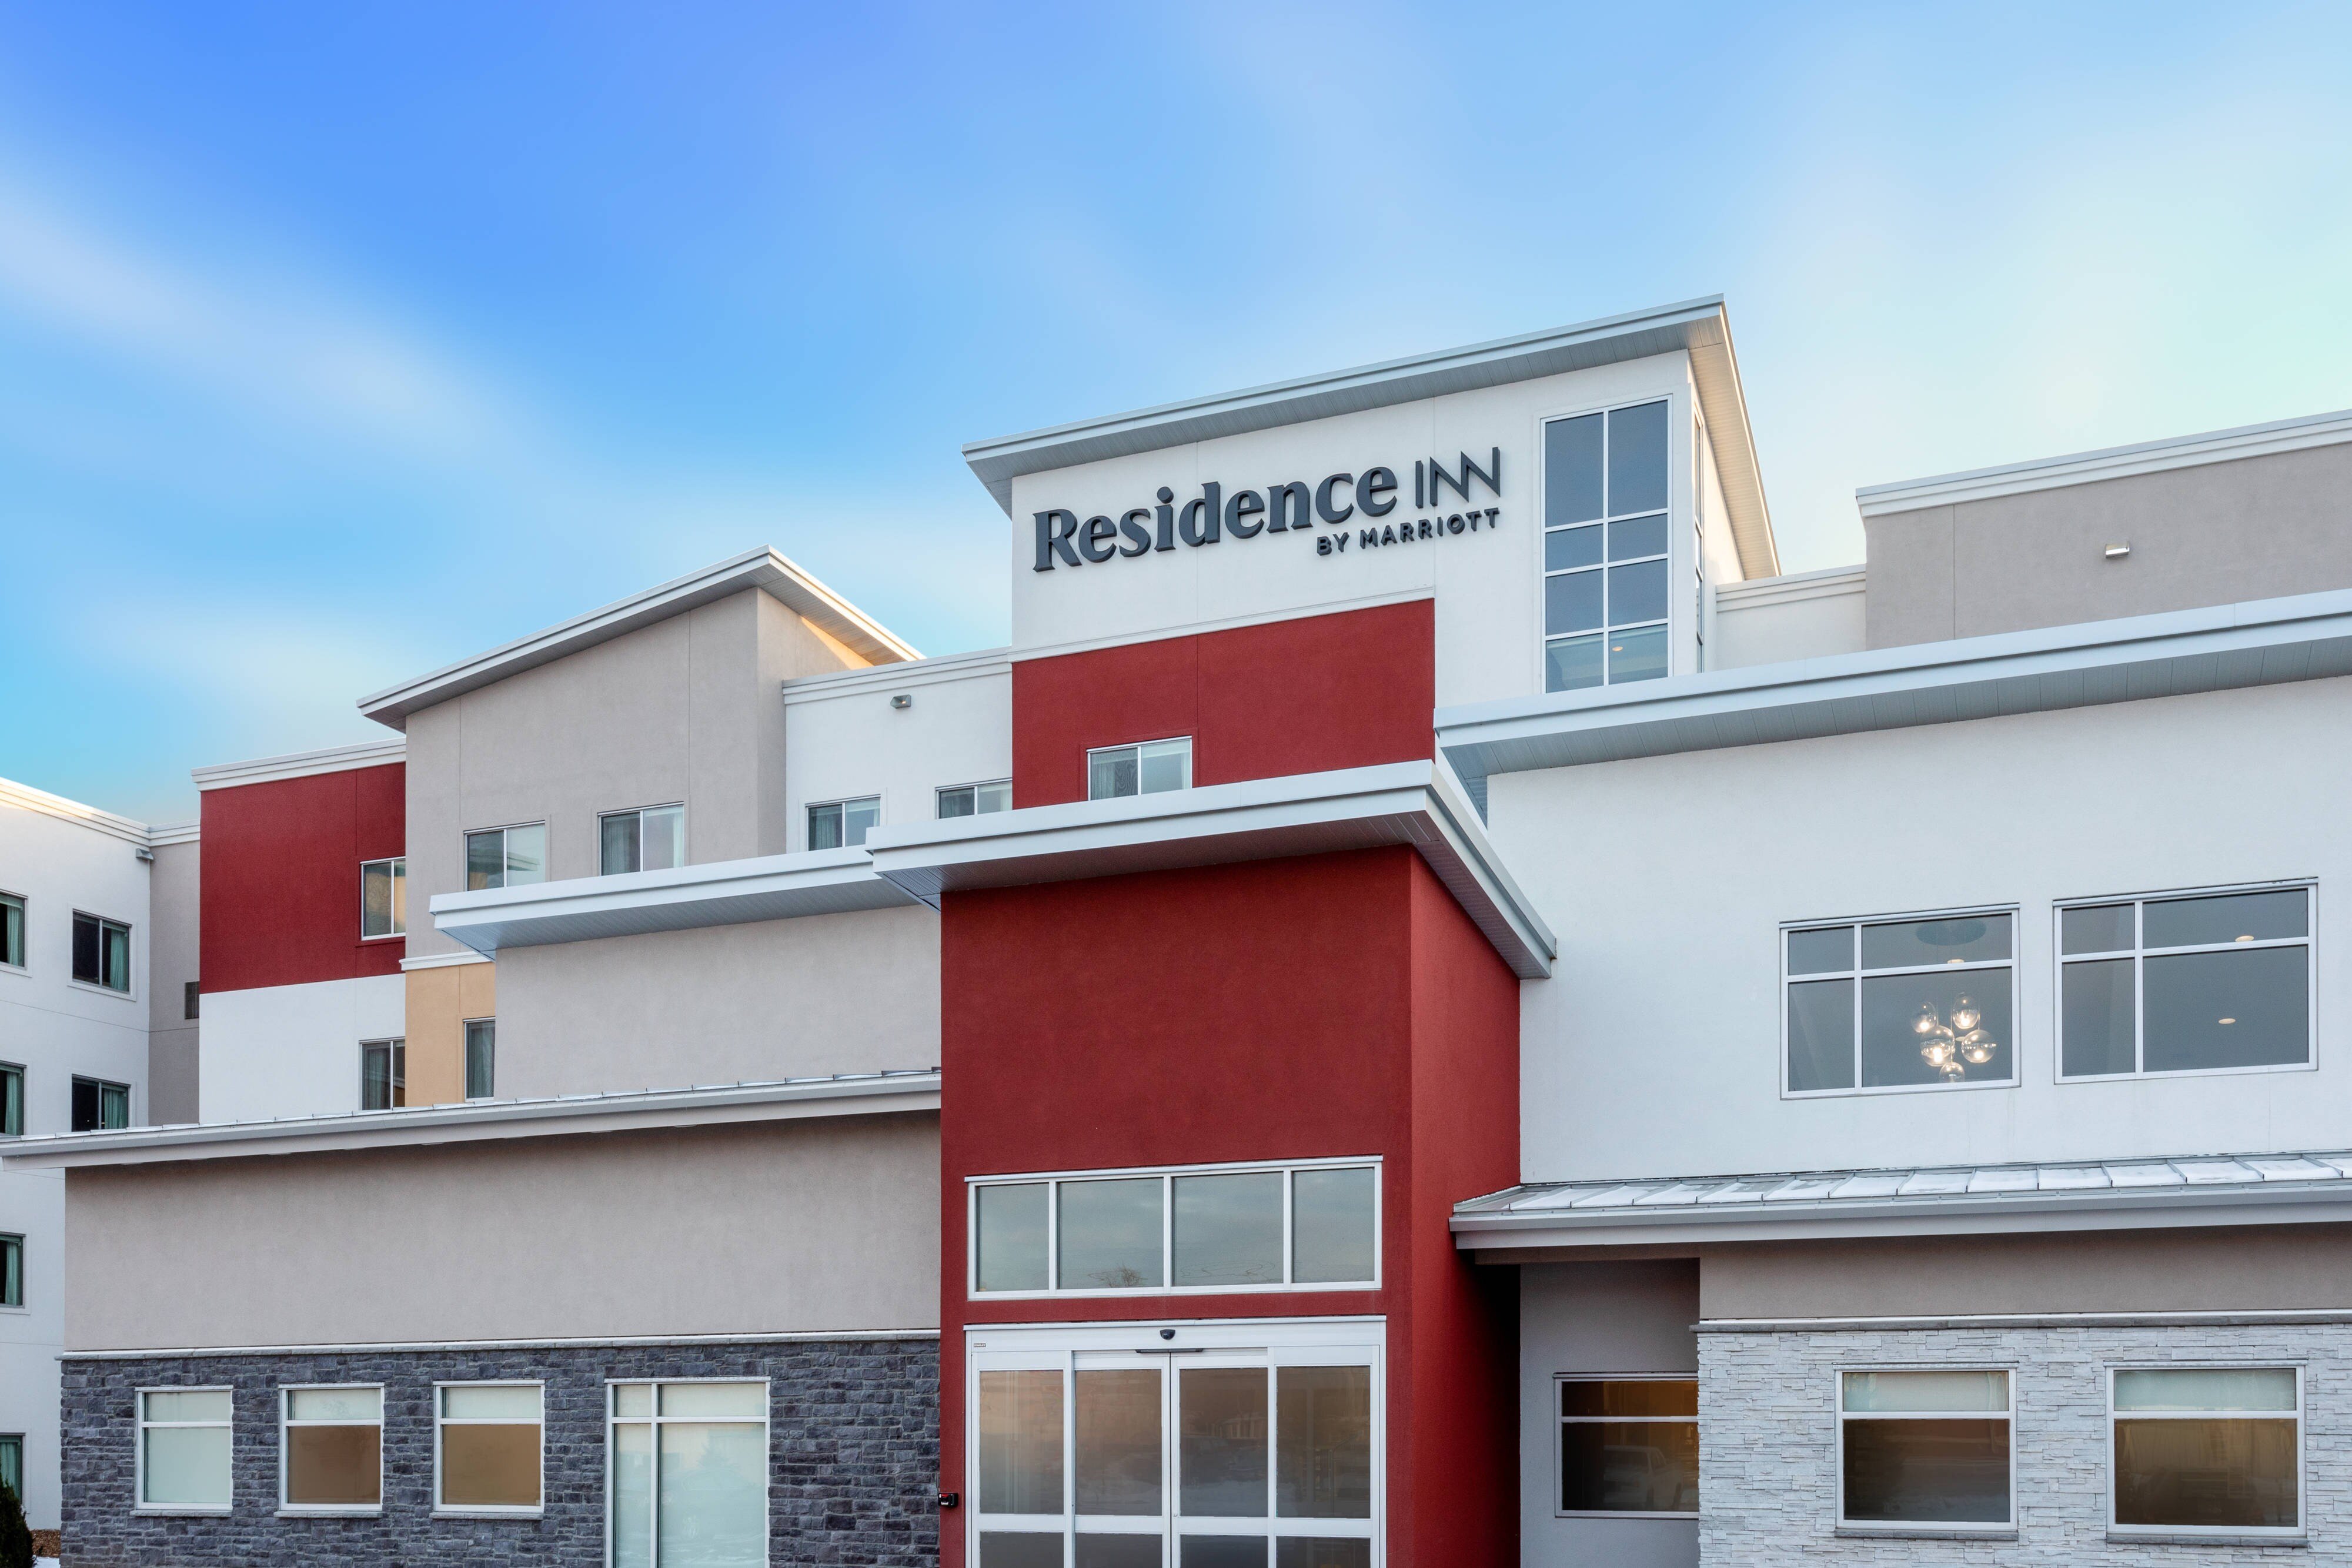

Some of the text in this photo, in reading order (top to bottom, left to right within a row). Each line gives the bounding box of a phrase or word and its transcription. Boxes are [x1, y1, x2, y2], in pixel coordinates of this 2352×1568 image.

[1032, 446, 1501, 573] Residence INN
[1317, 507, 1500, 556] BY MARRIOTT
